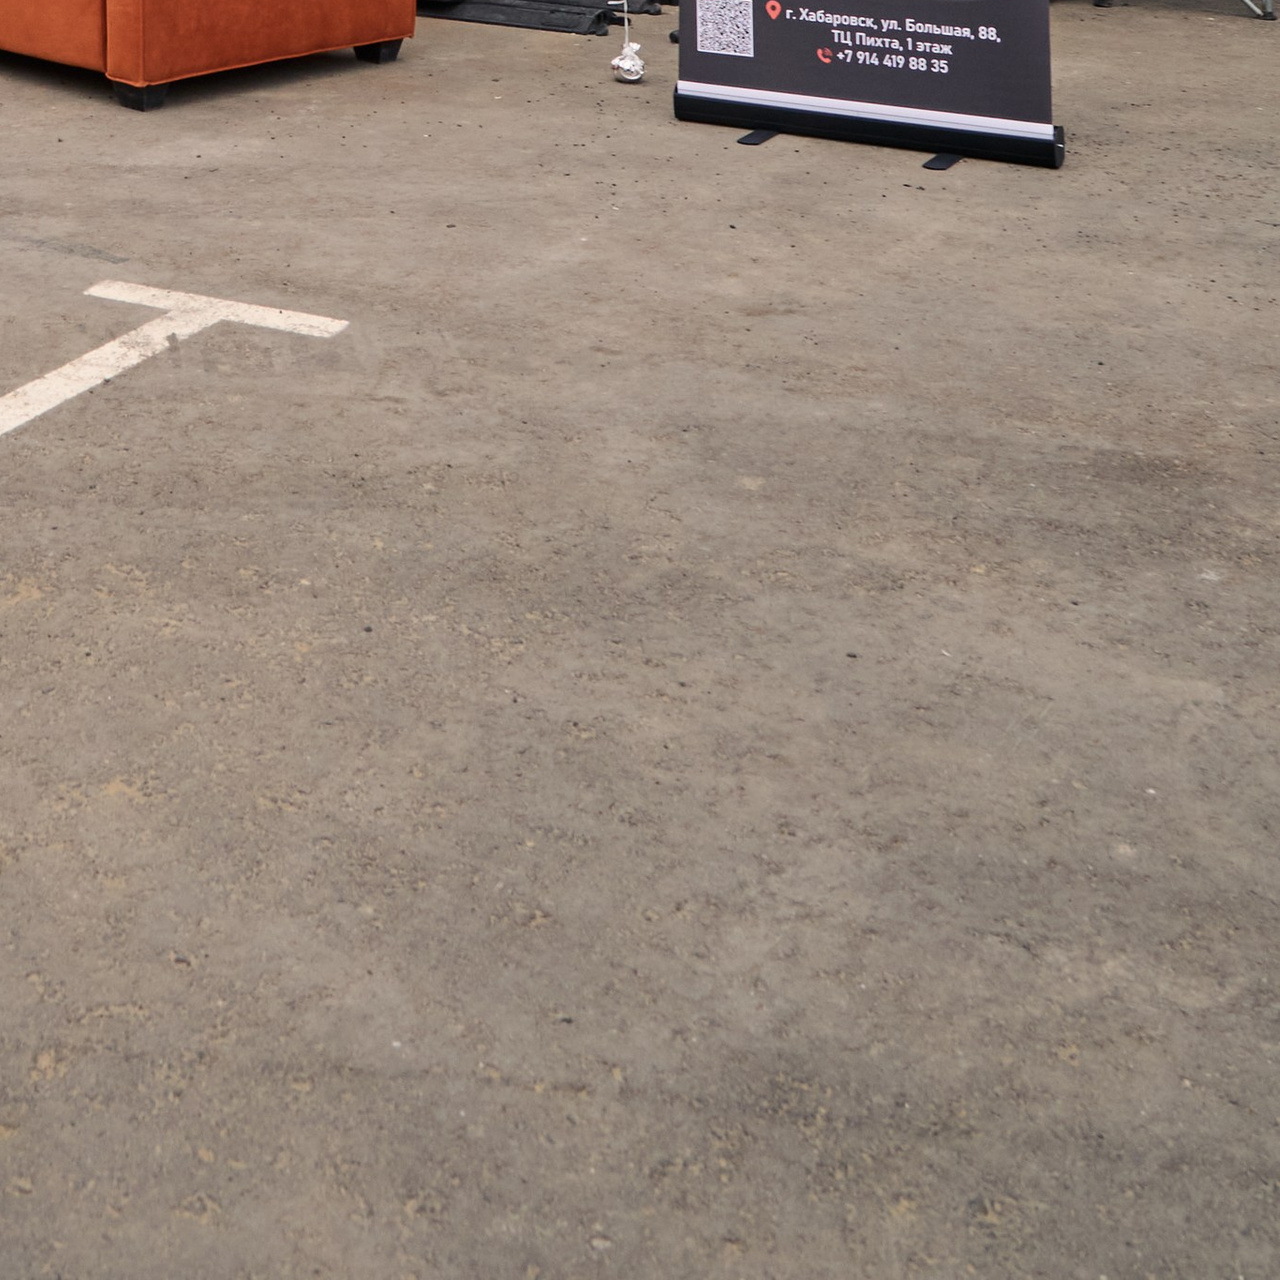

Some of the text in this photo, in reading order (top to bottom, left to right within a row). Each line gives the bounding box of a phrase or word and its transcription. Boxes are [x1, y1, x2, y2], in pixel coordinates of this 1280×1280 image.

[785, 7, 1003, 43] г. Хабаровск, ул. Большая, 88,
[830, 28, 954, 56] ТЦ Пихта, 1 этаж
[836, 49, 950, 75] +7 914 419 88 35
